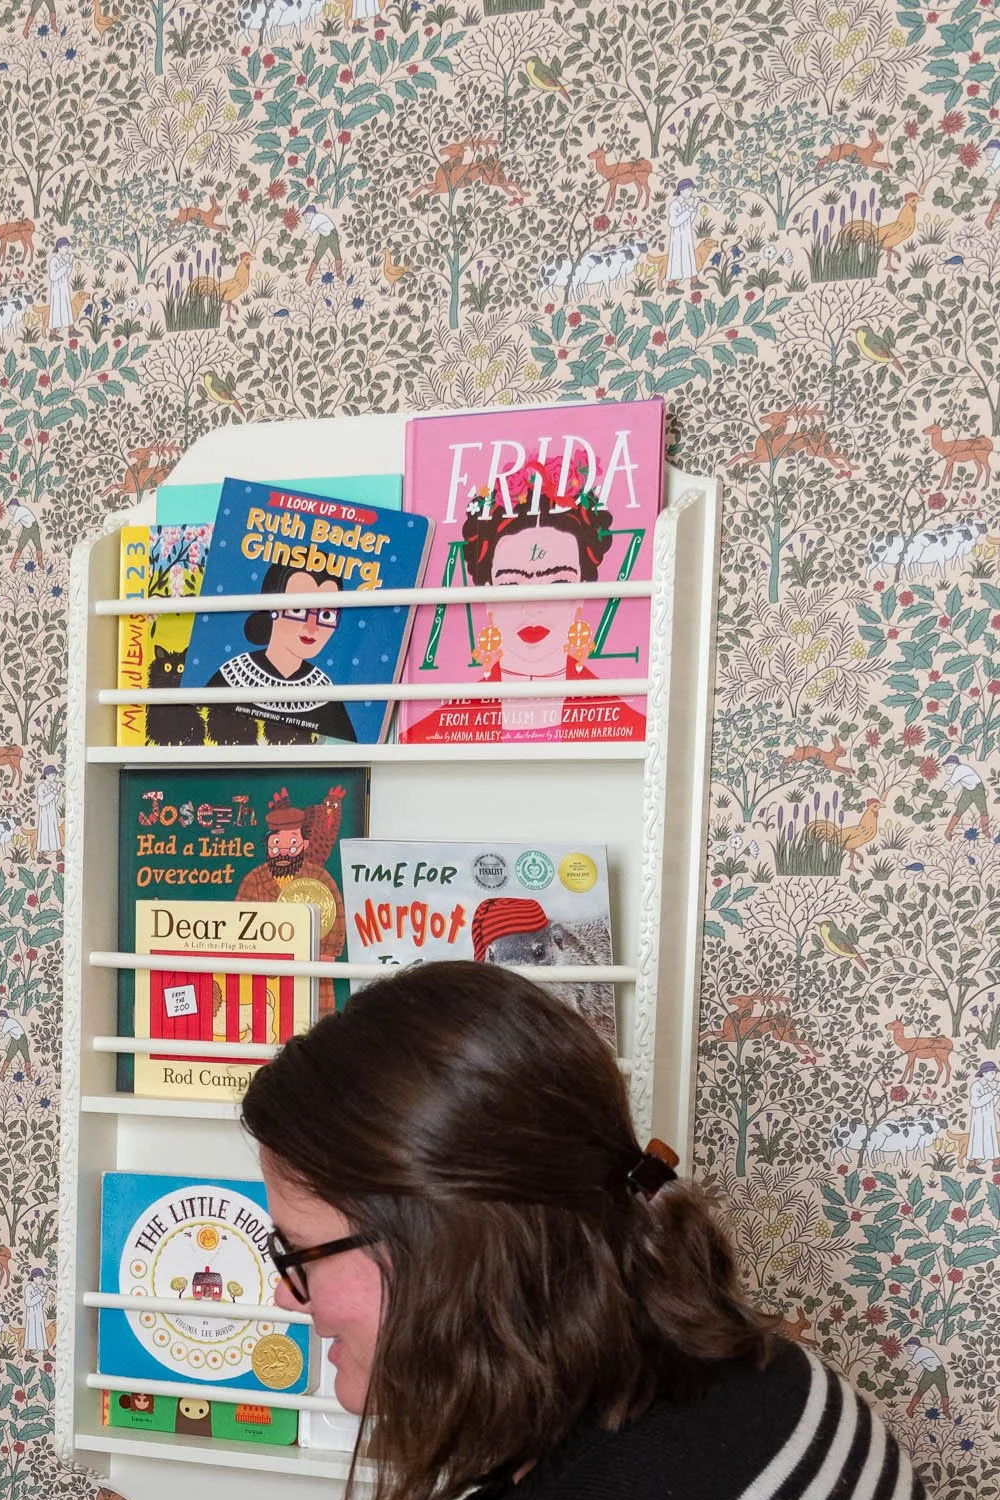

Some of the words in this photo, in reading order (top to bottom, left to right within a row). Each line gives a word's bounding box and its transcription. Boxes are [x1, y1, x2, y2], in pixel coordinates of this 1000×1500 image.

[443, 430, 640, 523] FRIDA
[279, 495, 285, 507] I
[287, 498, 316, 513] LOOK
[319, 503, 337, 516] UP
[246, 507, 306, 540] Ruth
[310, 519, 390, 555] Bader
[126, 539, 146, 553] 3
[126, 563, 145, 578] 2
[241, 533, 383, 592] Ginsburg
[528, 543, 546, 562] to
[588, 528, 646, 664] Z
[439, 712, 469, 726] FROM
[474, 711, 534, 726] ACTIVISM
[543, 709, 557, 723] TO
[562, 707, 620, 723] ZAPOTEC
[450, 732, 473, 741] NADIA
[475, 730, 501, 741] BAILEY
[554, 729, 589, 739] SUSANNA
[591, 727, 633, 739] HARRISON
[138, 791, 257, 834] Joseph
[137, 834, 177, 857] Had
[183, 842, 194, 856] a
[198, 837, 255, 857] Little
[136, 863, 235, 887] Overcoat
[351, 862, 407, 888] TIME
[413, 862, 458, 888] FOR
[151, 909, 226, 940] Dear
[238, 911, 295, 942] Zoo
[354, 898, 467, 947] Margot
[171, 991, 186, 999] FROM
[174, 1003, 190, 1012] ZOO
[163, 1067, 193, 1085] Rod
[135, 1214, 168, 1254] THE
[168, 1196, 231, 1224] LITTLE
